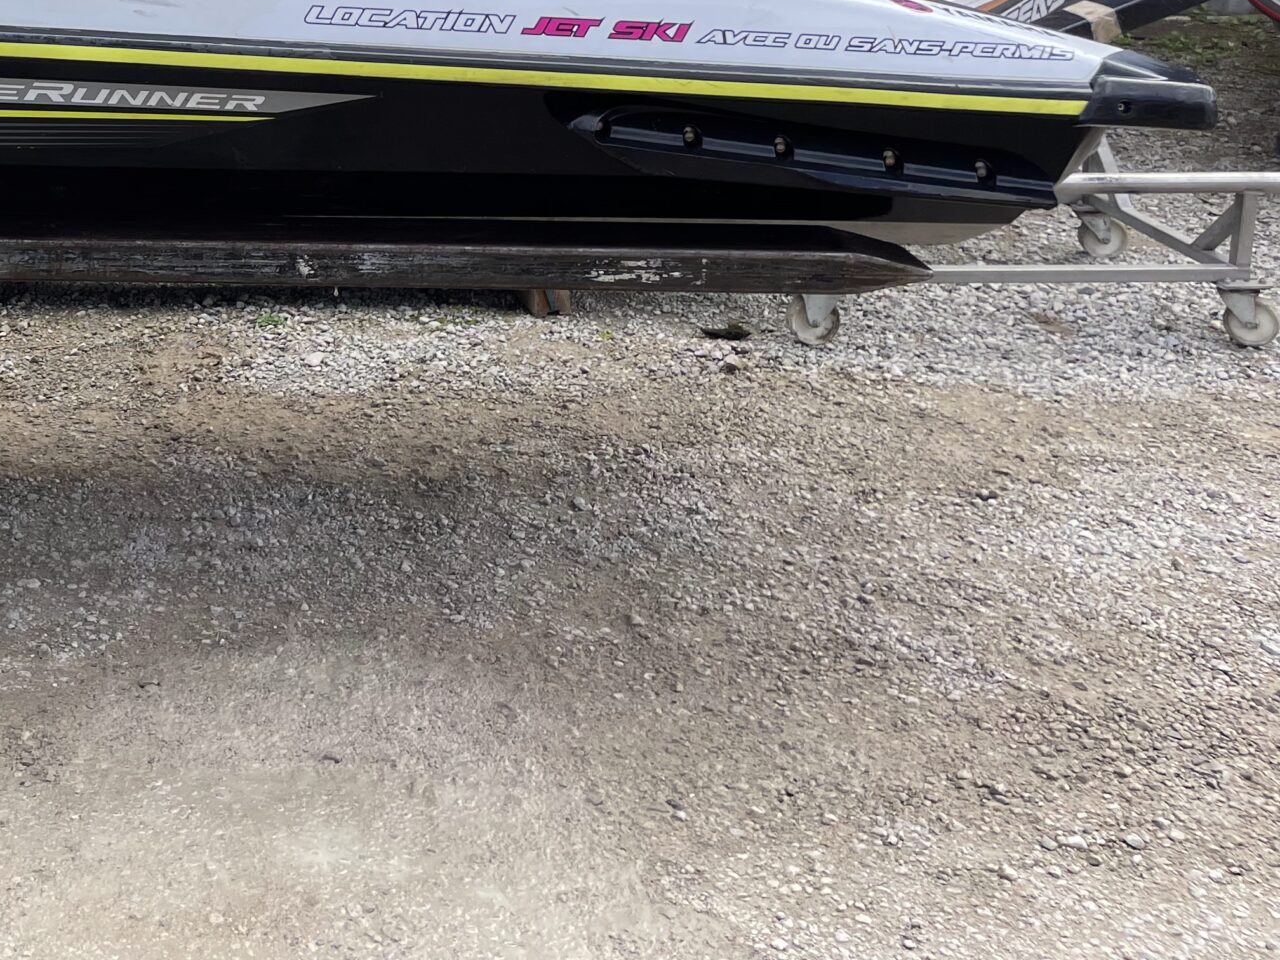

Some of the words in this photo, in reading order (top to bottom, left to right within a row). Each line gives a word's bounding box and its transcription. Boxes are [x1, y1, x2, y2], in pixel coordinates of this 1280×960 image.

[304, 5, 517, 34] LOCATION
[520, 16, 606, 39] JET
[608, 19, 695, 43] SKI
[697, 28, 791, 48] AVEC
[795, 32, 841, 51] OU
[845, 35, 1075, 61] SANS-PERMIS
